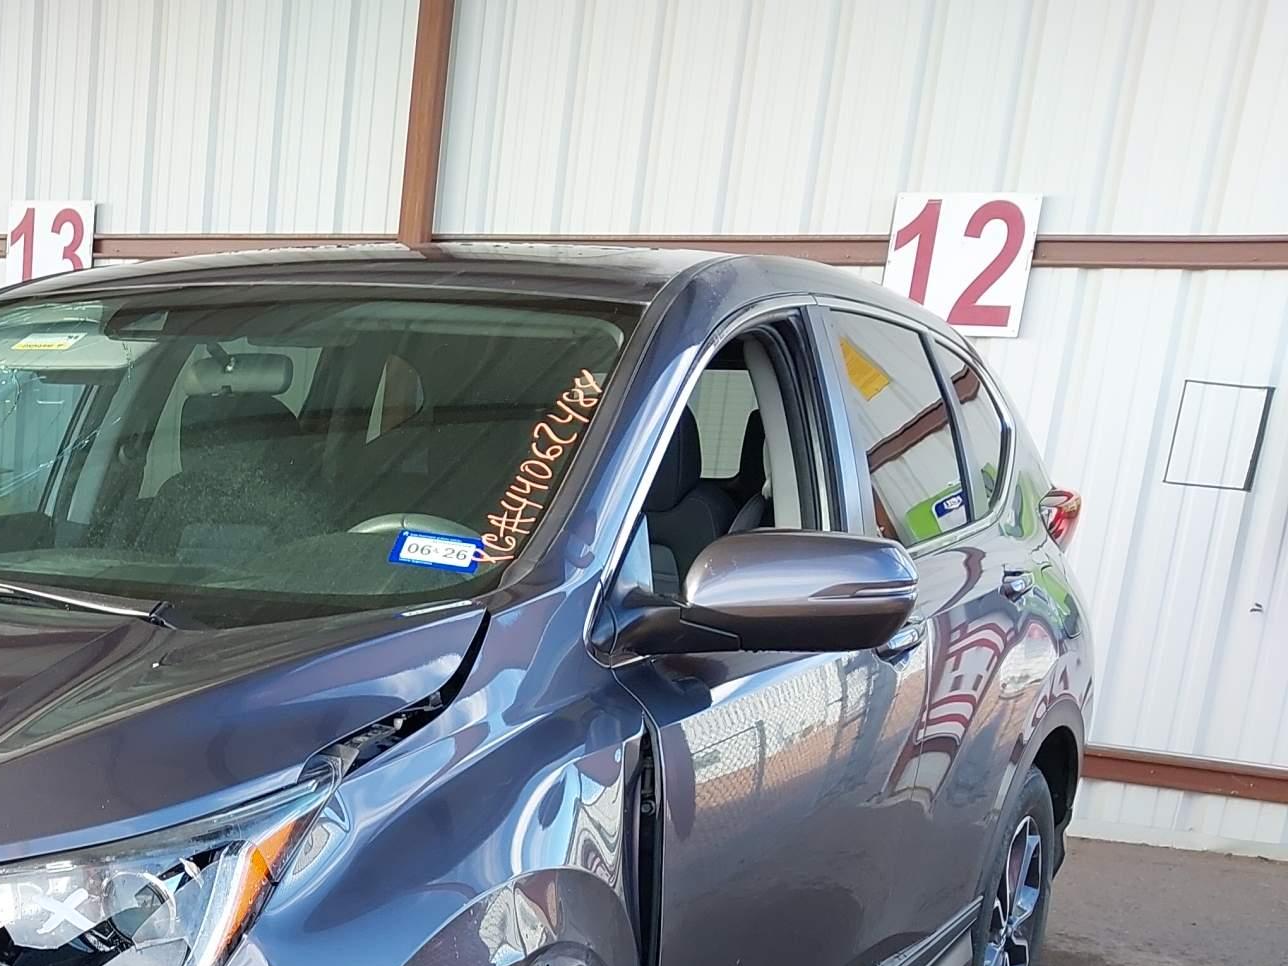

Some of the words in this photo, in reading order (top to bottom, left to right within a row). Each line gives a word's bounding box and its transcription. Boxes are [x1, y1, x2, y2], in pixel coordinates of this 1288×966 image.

[10, 207, 85, 281] 13
[894, 199, 1026, 327] 12
[407, 542, 432, 556] 06
[442, 547, 469, 561] 26
